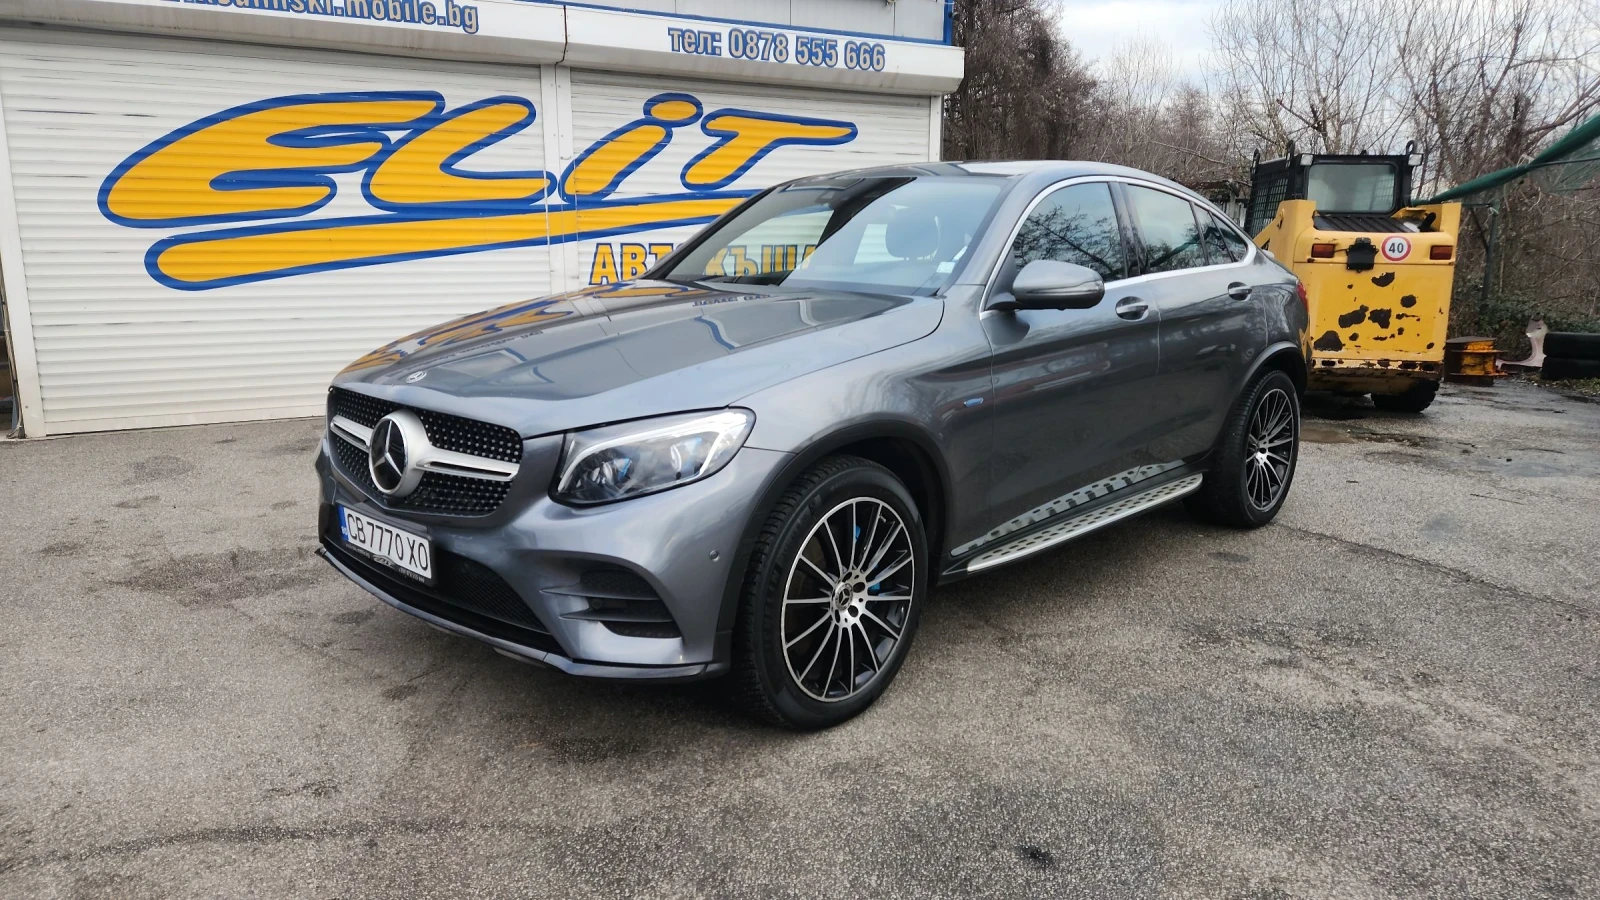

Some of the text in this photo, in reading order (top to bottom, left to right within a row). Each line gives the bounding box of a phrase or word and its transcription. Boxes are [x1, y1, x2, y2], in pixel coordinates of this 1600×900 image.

[668, 27, 886, 72] тел: 0878 555 666
[1389, 243, 1404, 253] 40
